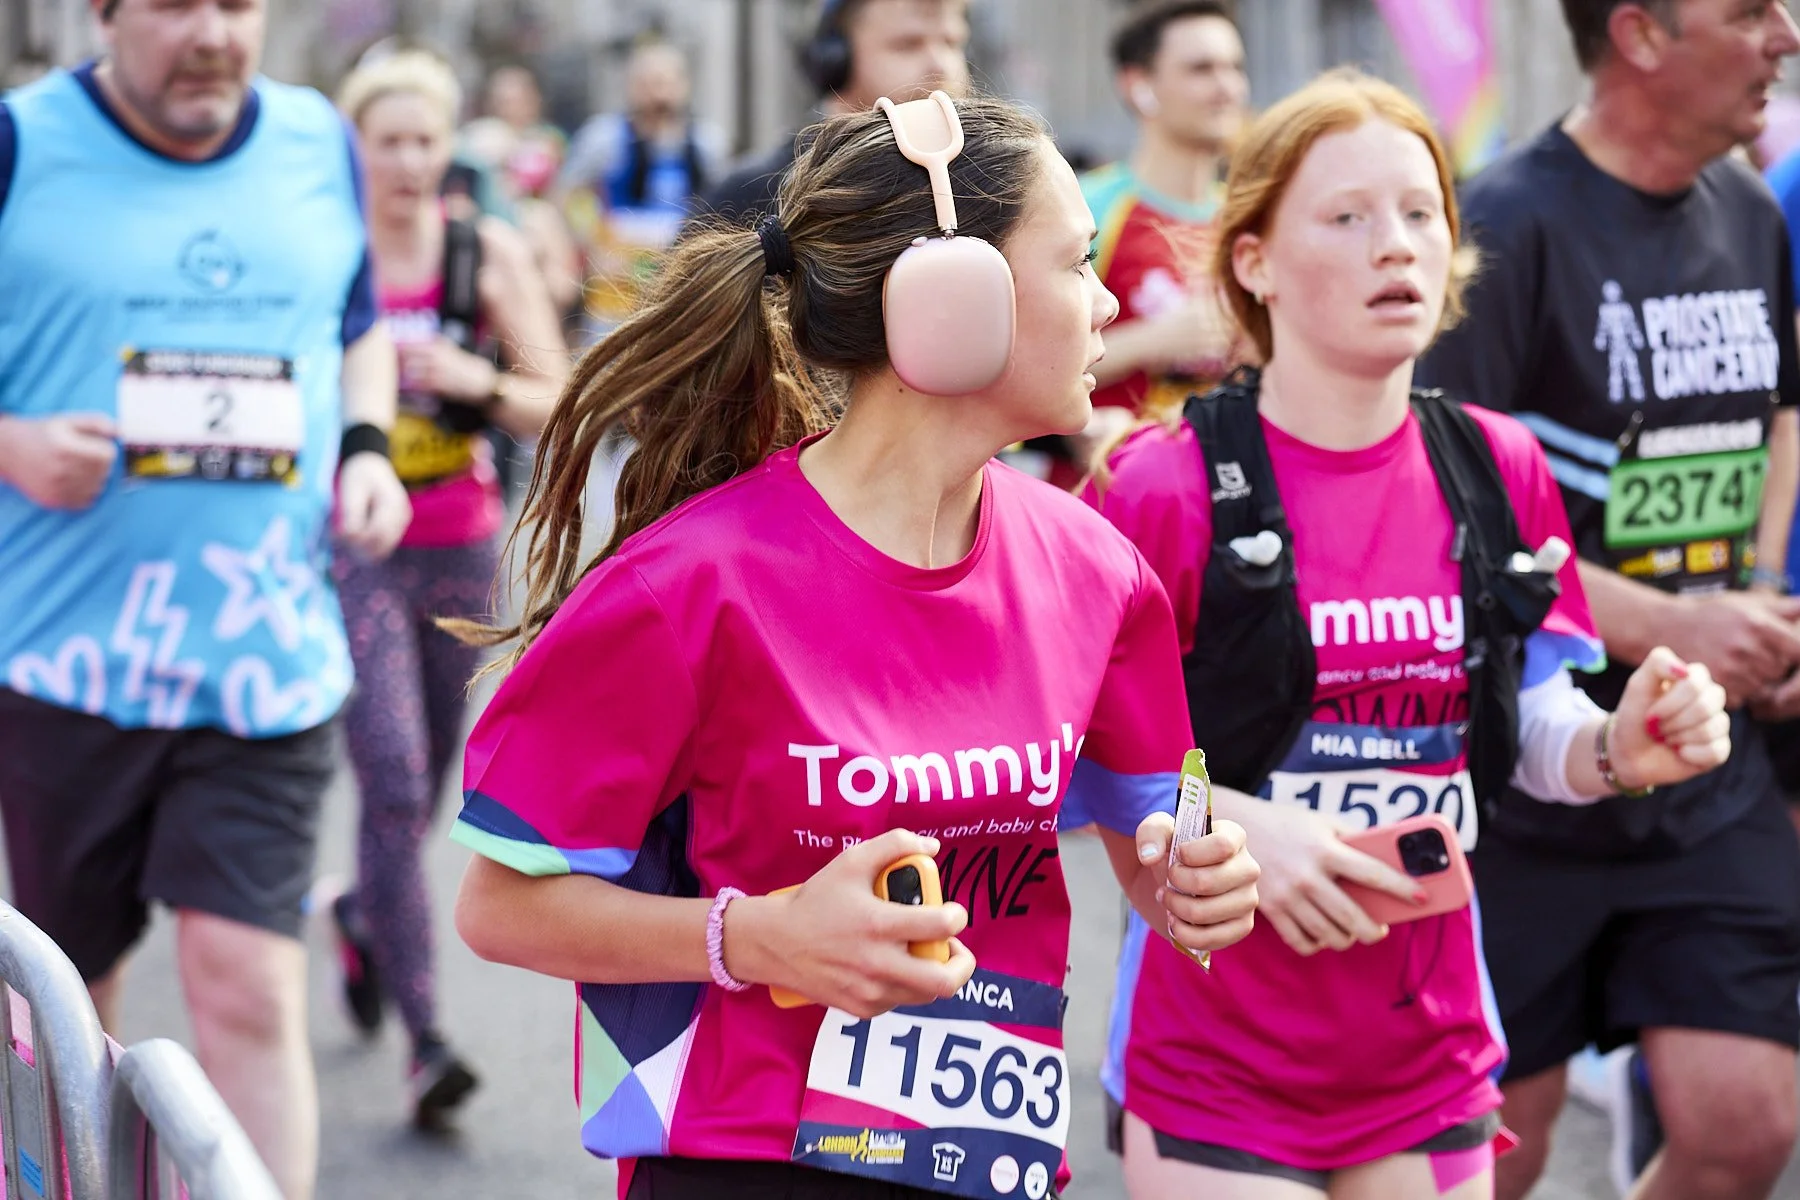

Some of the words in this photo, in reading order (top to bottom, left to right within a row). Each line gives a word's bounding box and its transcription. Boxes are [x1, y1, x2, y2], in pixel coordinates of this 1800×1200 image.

[203, 389, 233, 436] 2
[1621, 463, 1762, 527] 2374
[1310, 595, 1464, 652] mmy
[1311, 732, 1358, 758] MIA
[1361, 736, 1421, 760] BELL
[793, 829, 833, 848] The
[943, 820, 984, 838] and
[986, 816, 1035, 834] baby
[840, 1017, 1063, 1129] 11563
[818, 1135, 858, 1153] LONDON
[940, 1155, 953, 1173] XS
